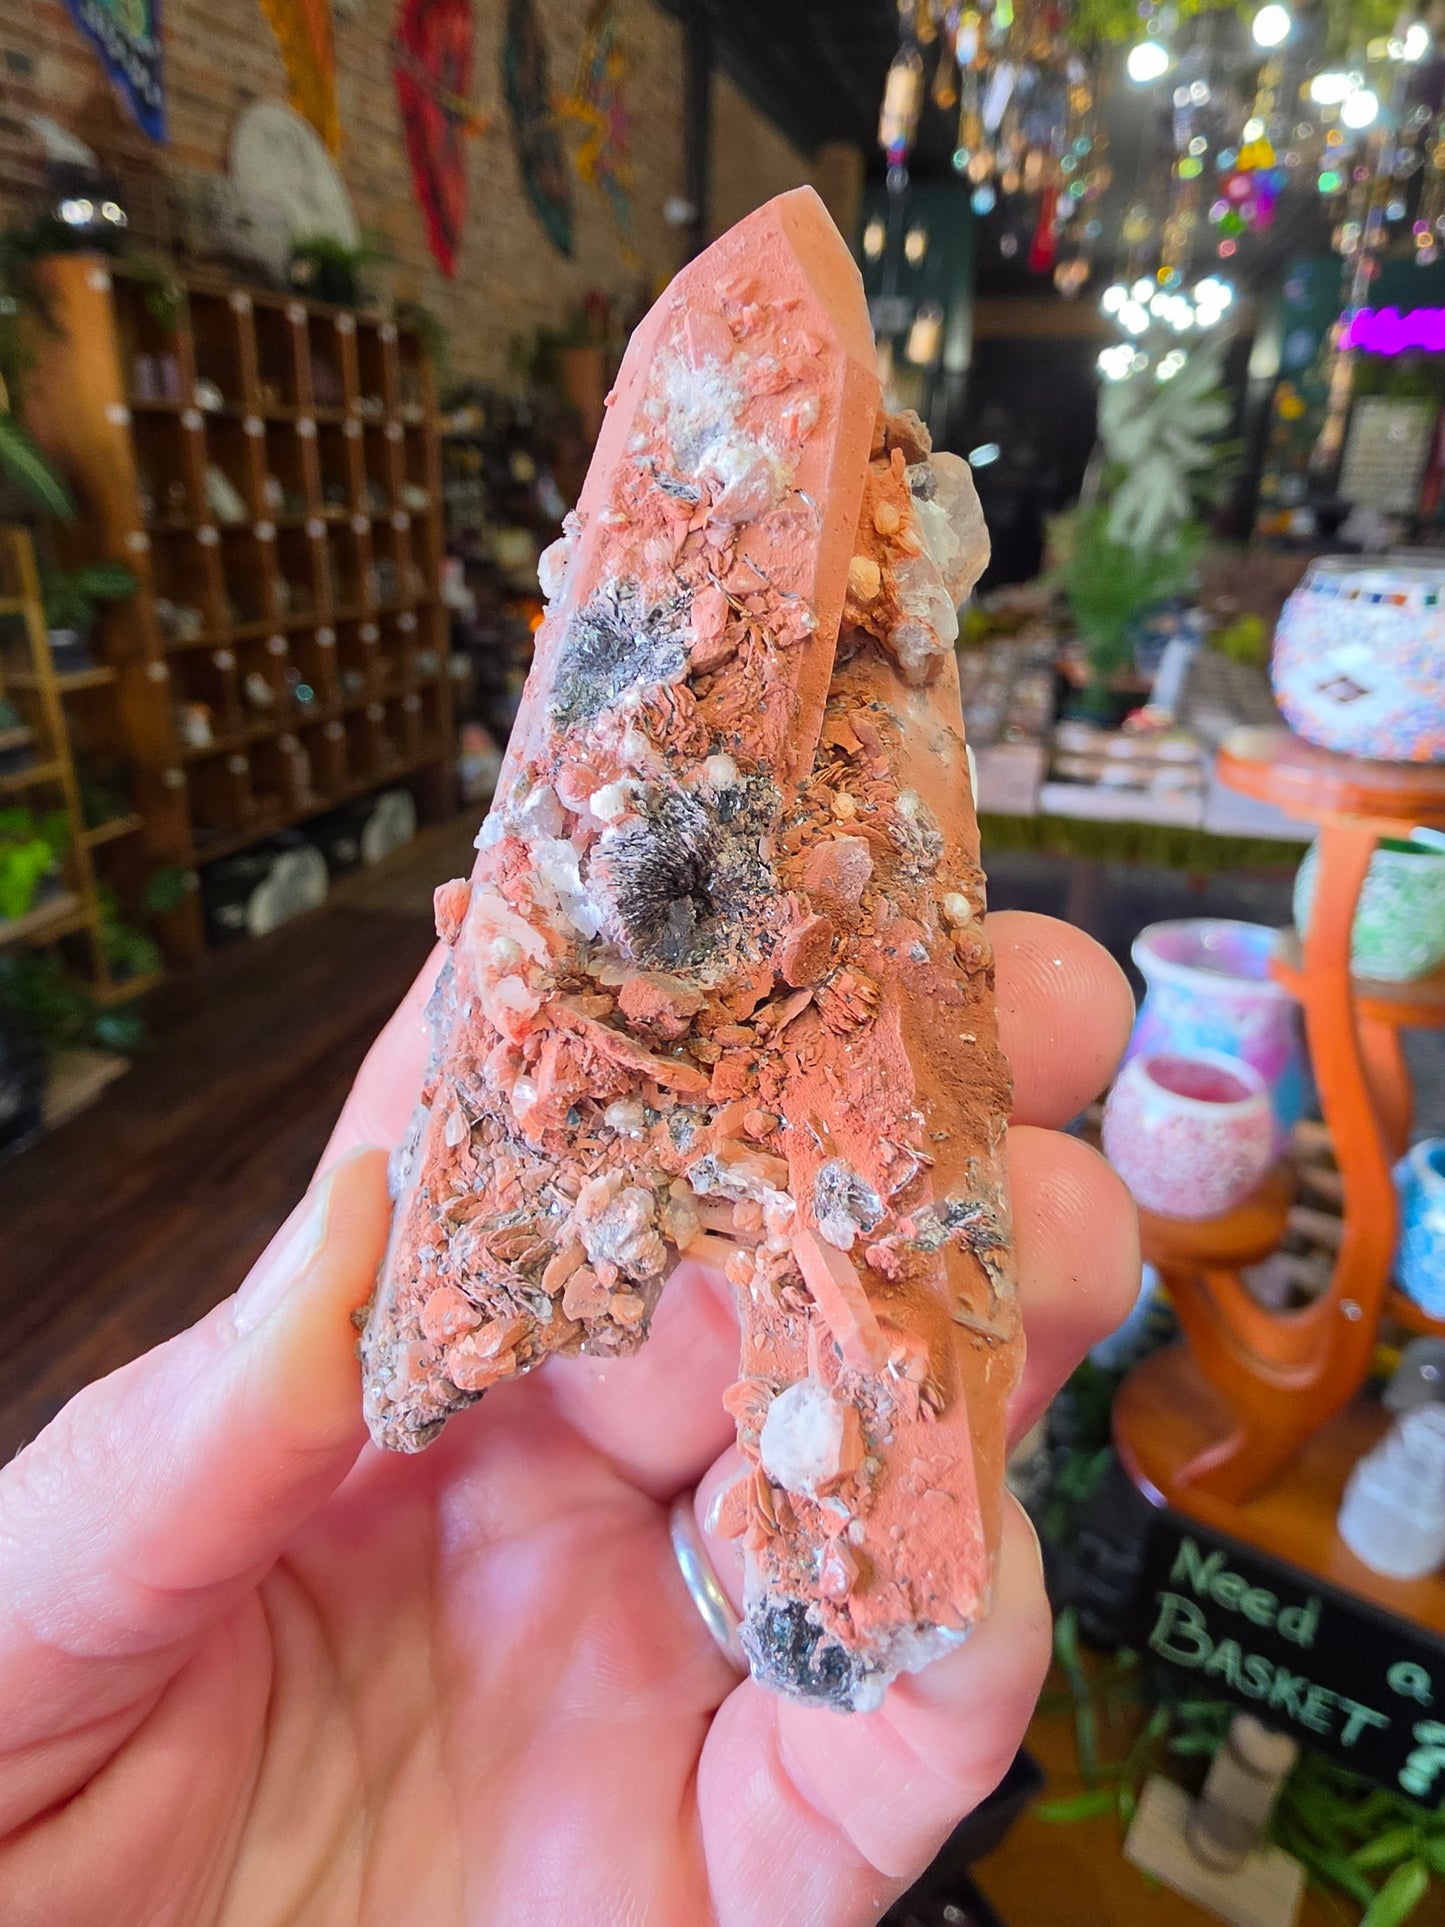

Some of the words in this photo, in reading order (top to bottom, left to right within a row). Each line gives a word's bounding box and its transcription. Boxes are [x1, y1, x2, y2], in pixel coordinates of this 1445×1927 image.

[1148, 1591, 1391, 1747] BASKET
[1169, 1536, 1322, 1648] Need
[1386, 1661, 1434, 1706] a
